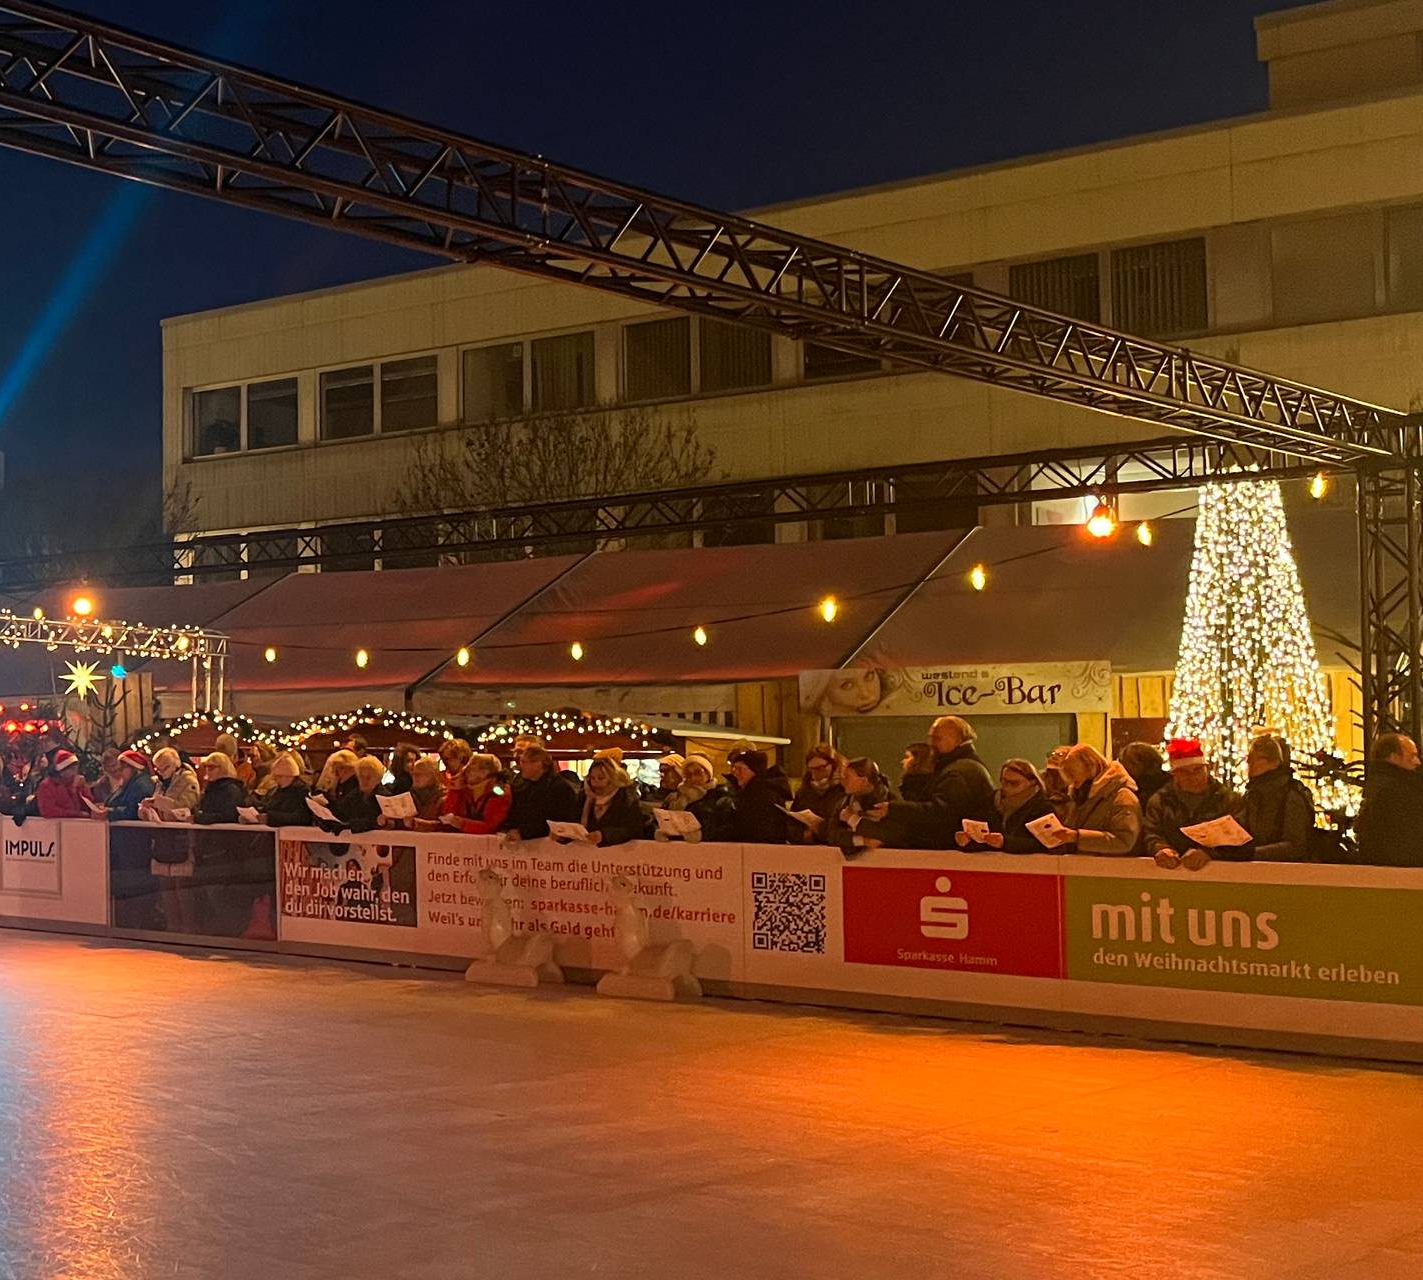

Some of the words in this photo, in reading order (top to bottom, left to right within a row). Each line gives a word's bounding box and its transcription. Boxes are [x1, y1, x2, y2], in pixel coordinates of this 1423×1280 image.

[923, 676, 1061, 706] Ice-Bar
[284, 862, 309, 880] Wir
[311, 864, 365, 882] machen
[427, 852, 460, 866] Finde
[463, 854, 483, 868] mit
[512, 856, 528, 870] im
[531, 858, 564, 872] Team
[568, 860, 588, 874] die
[591, 861, 691, 882] Unterstützung
[695, 866, 723, 880] und
[427, 869, 450, 882] den
[512, 874, 547, 889] deine
[285, 882, 310, 897] den
[312, 882, 338, 899] Job
[340, 885, 379, 904] wahr,
[381, 887, 410, 904] den
[429, 890, 457, 903] Jetzt
[285, 898, 303, 914] du
[305, 900, 327, 917] dir
[326, 903, 398, 922] vorstellst.
[1091, 892, 1176, 944] mit
[1187, 907, 1280, 951] uns
[428, 911, 465, 927] Weil's
[528, 919, 548, 933] als
[550, 921, 581, 936] Geld
[897, 948, 955, 964] Sparkasse
[959, 953, 998, 966] Hamm
[1093, 948, 1128, 967] den
[1134, 952, 1312, 980] Weihnachtsmarkt
[1318, 962, 1400, 985] erleben
